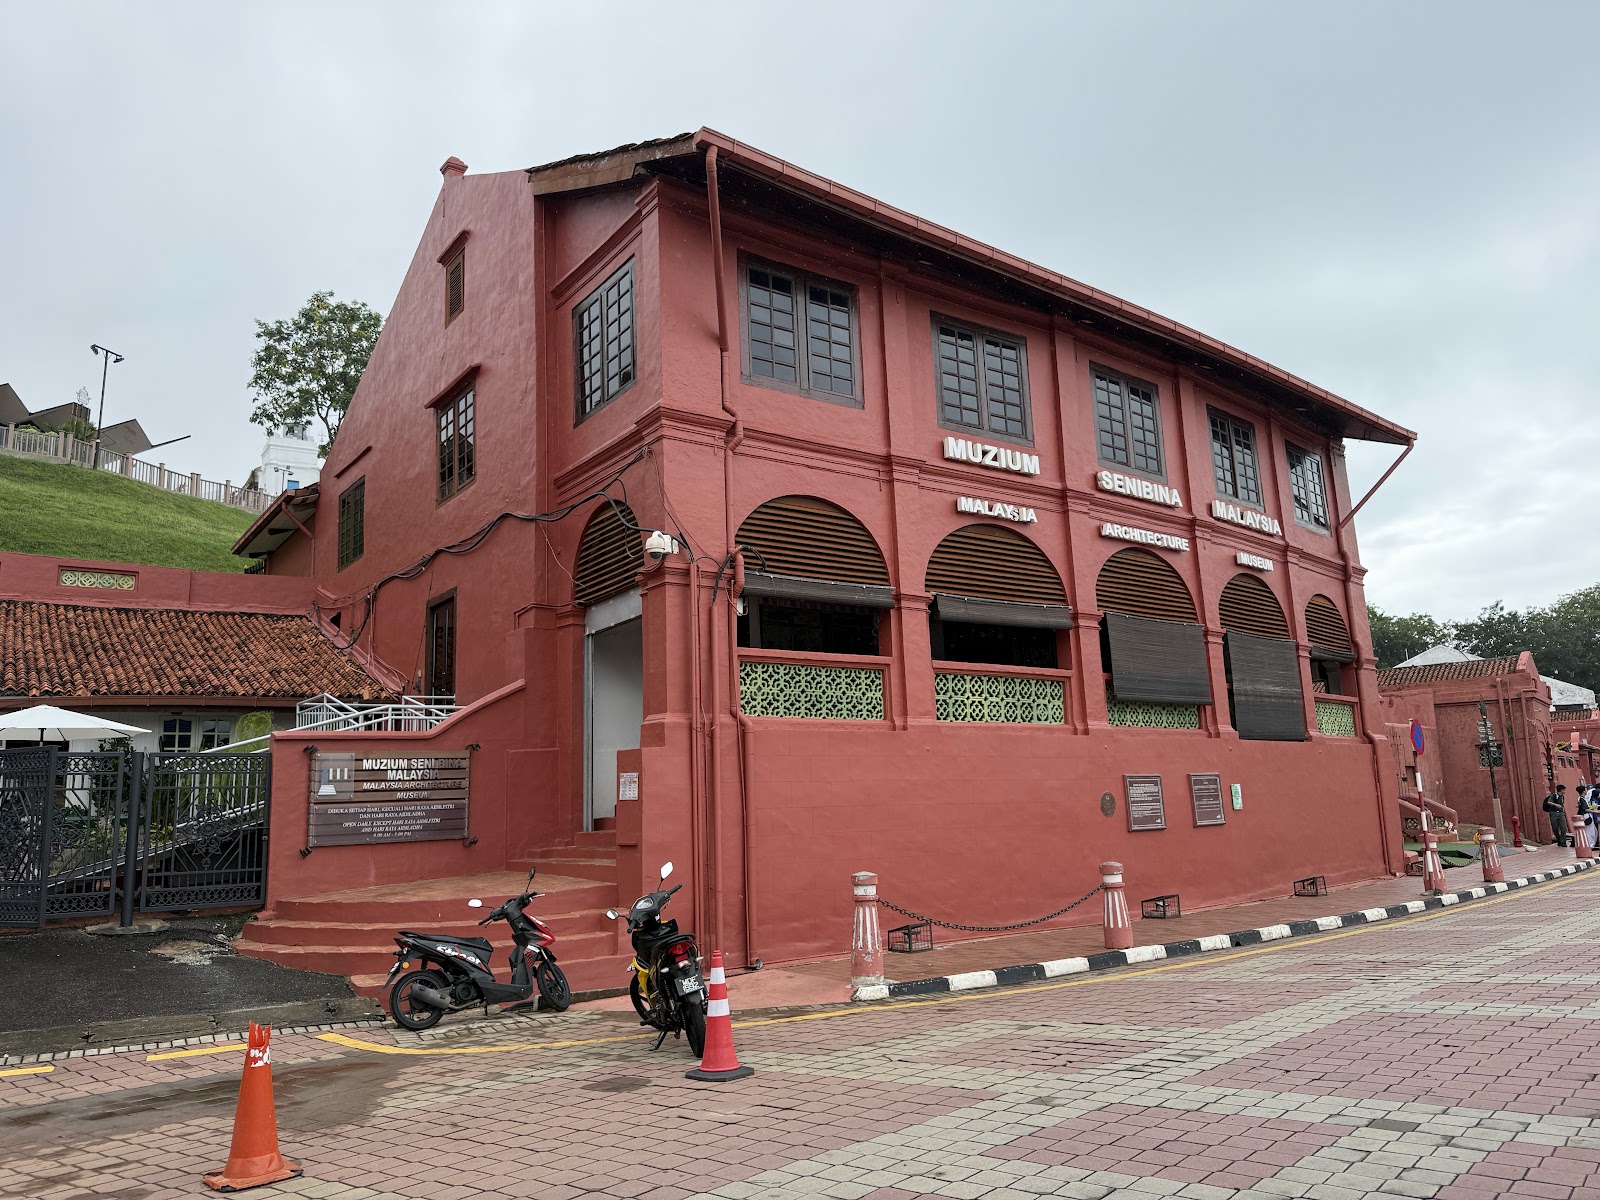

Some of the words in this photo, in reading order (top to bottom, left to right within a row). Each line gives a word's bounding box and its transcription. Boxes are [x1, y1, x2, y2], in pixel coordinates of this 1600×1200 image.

[943, 437, 1040, 475] MUZIUM
[1098, 471, 1183, 507] SENIBINA
[1212, 500, 1282, 536] MALAYSIA
[957, 497, 1038, 523] MALAYSIA
[1102, 522, 1190, 551] ARCHITECTURE
[1237, 552, 1274, 571] MUSEUM
[362, 759, 408, 770] MUZIUM
[410, 758, 435, 769] SENI
[387, 769, 440, 780] MALAYSIA
[362, 782, 403, 790] MALAYSIA
[403, 780, 462, 789] ARCHITECTURE
[396, 791, 431, 799] MUSEUM
